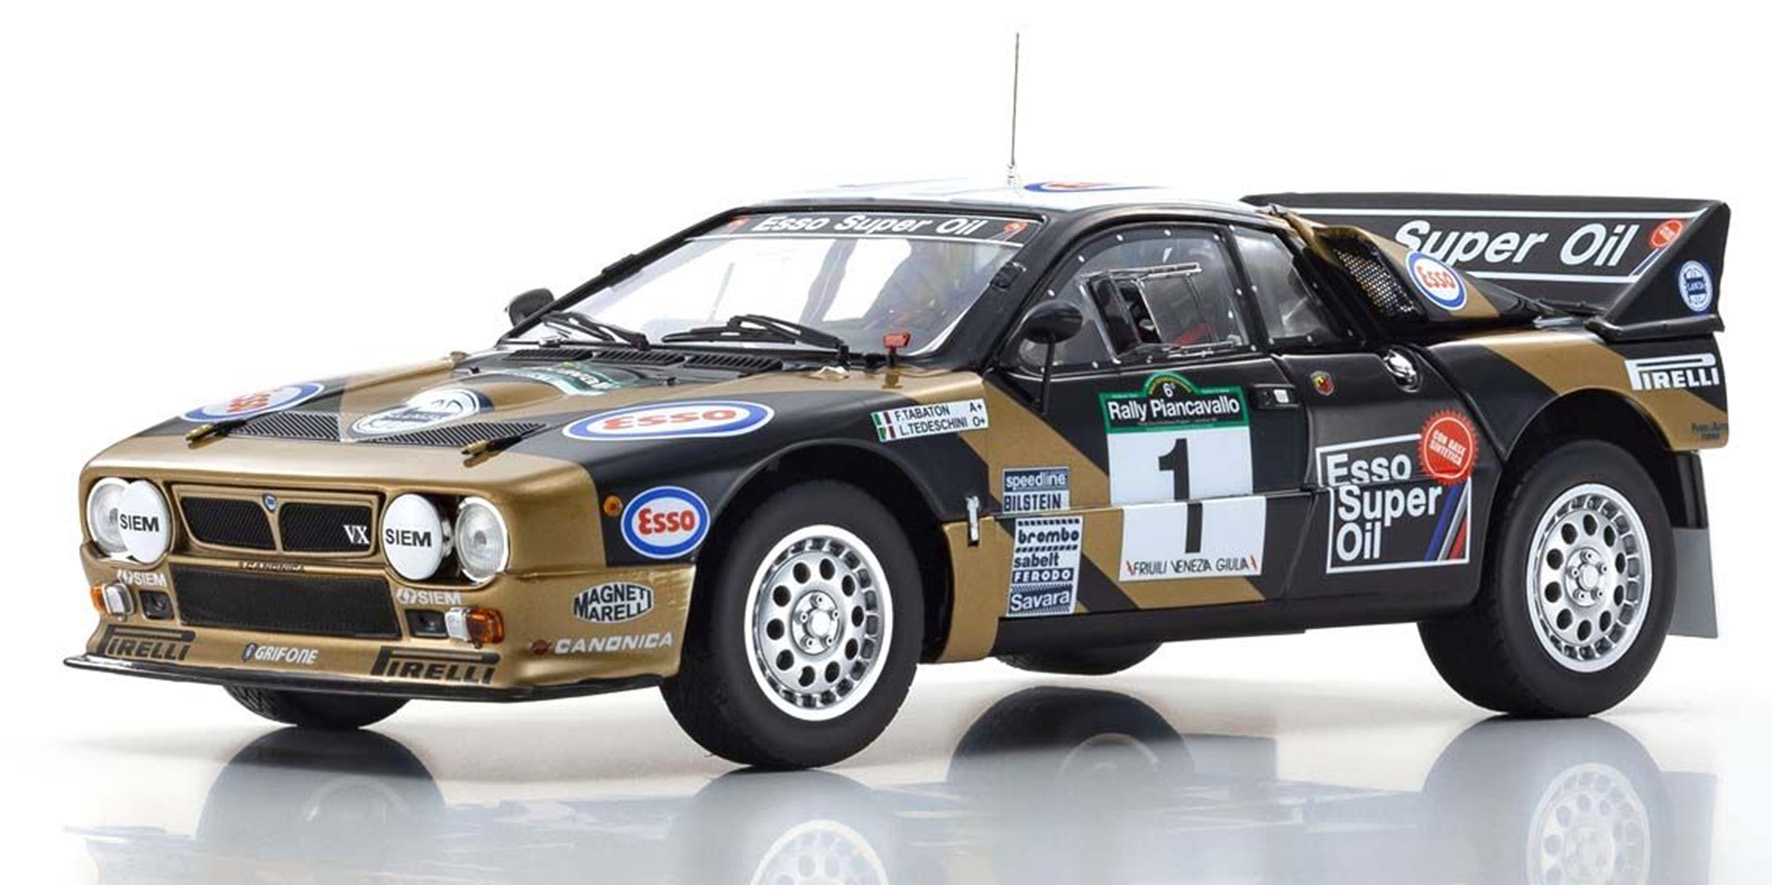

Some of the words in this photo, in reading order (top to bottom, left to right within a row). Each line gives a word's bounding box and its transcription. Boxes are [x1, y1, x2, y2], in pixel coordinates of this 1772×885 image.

[753, 216, 828, 232] Esso
[836, 215, 932, 234] Super
[935, 218, 987, 235] Oil
[1393, 220, 1548, 268] Super
[1559, 224, 1640, 267] Oil
[1625, 354, 1719, 391] PIRELLI
[894, 405, 950, 421] F.TABATON
[1107, 402, 1147, 421] Rally
[1151, 395, 1240, 417] Piancavallo
[900, 418, 968, 436] L.TEDESCHINI
[1326, 453, 1412, 487] Esso
[1005, 472, 1066, 490] speedline
[1004, 493, 1062, 513] BILSTEIN
[1158, 438, 1202, 554] 1
[1338, 485, 1442, 527] Super
[119, 515, 160, 532] SIEM
[343, 525, 370, 544] VX
[385, 528, 432, 548] SIEM
[1336, 522, 1382, 561] Oil
[1014, 553, 1059, 568] sabelt
[133, 573, 166, 587] SIEM
[1014, 570, 1071, 582] FERODO
[417, 591, 462, 605] SIEM
[1010, 591, 1070, 611] Savara
[99, 625, 195, 661] PIRELLI
[554, 632, 673, 654] CANONICA
[255, 646, 318, 664] GRIFONE
[371, 646, 499, 684] PIRELLI
